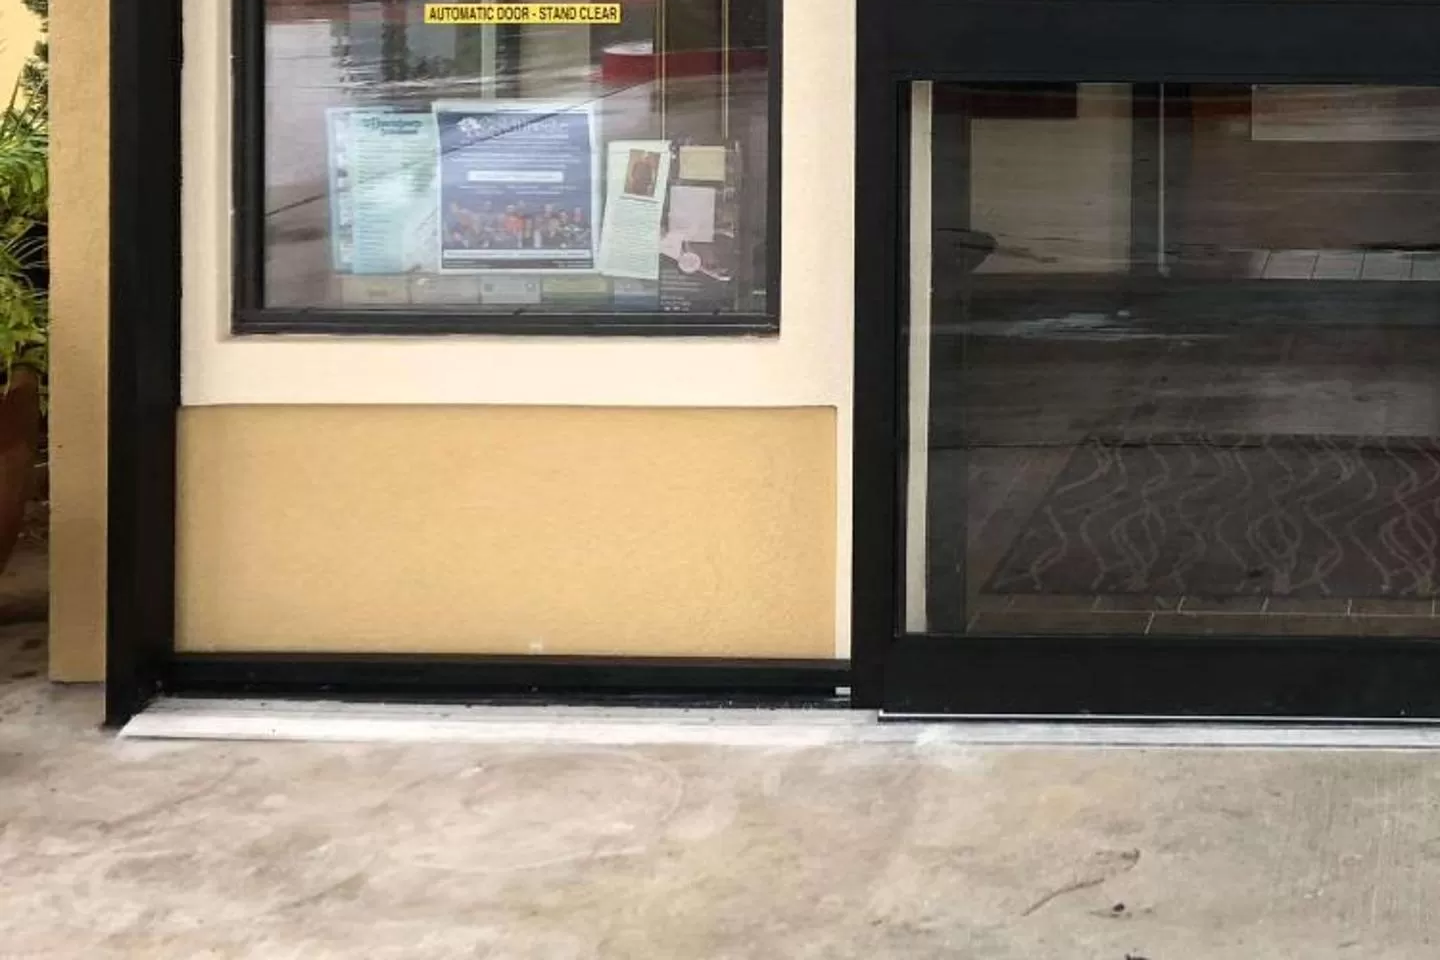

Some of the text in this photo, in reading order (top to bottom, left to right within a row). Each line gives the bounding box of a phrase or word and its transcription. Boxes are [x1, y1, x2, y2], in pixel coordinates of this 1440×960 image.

[430, 6, 494, 20] AUTOMATIC
[497, 6, 529, 20] DOOR
[539, 6, 576, 20] STAND
[579, 6, 617, 20] CLEAR
